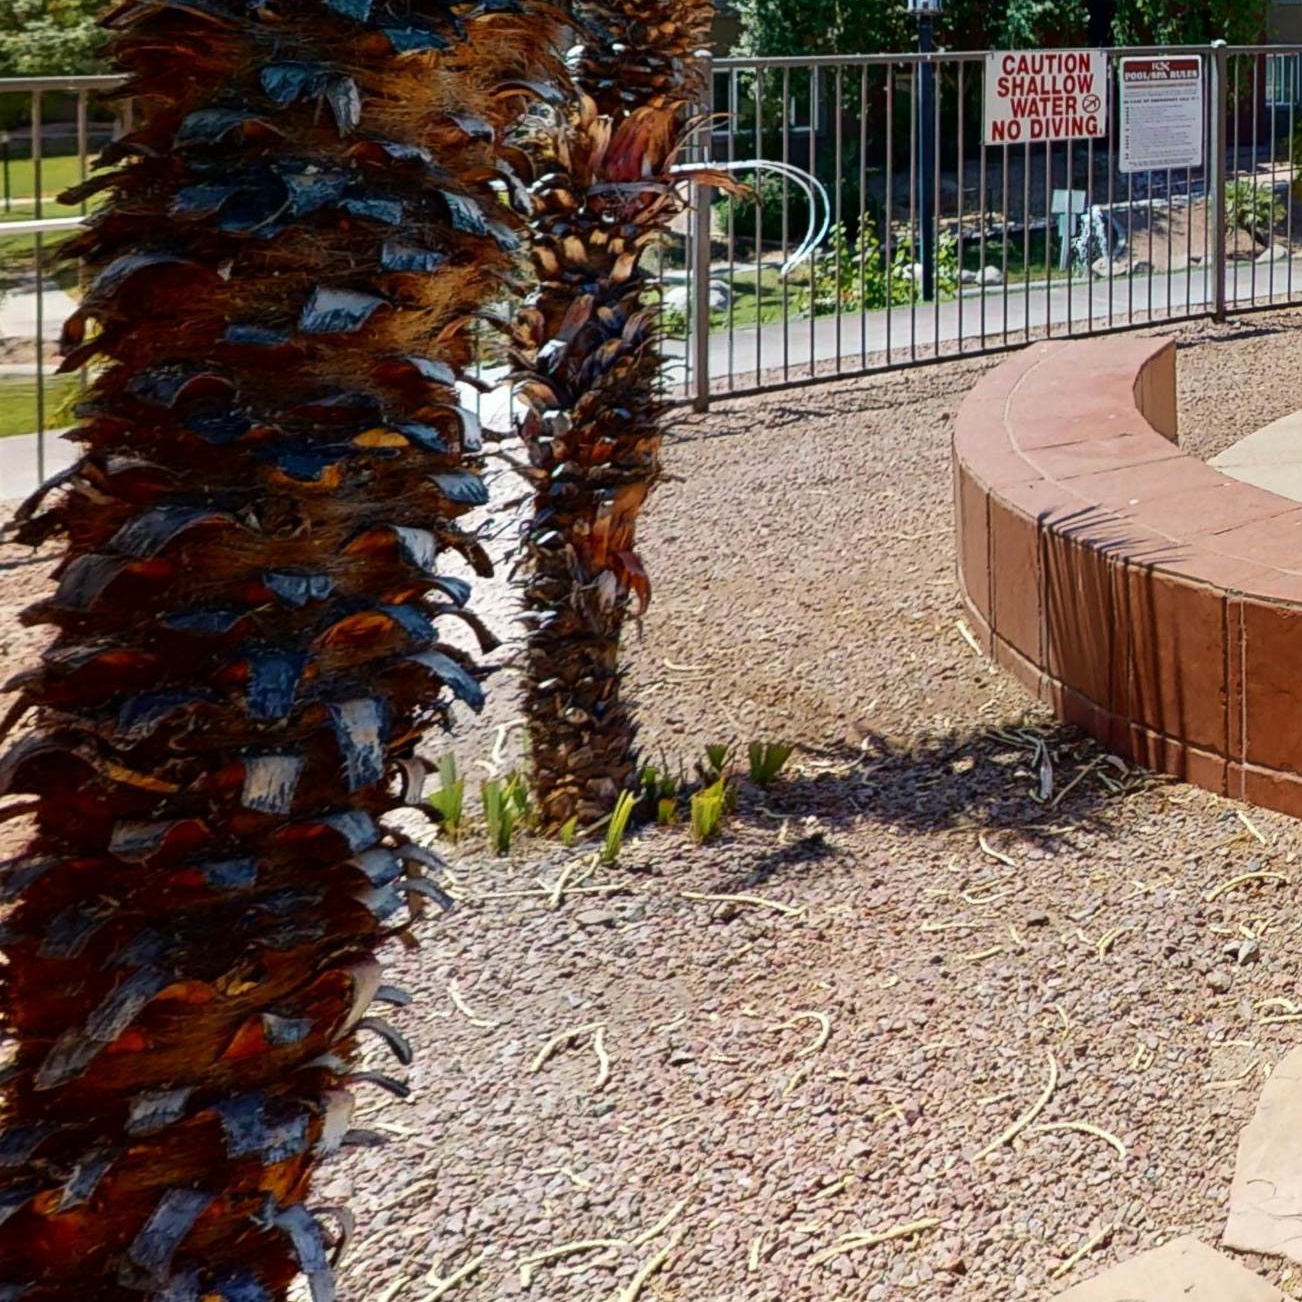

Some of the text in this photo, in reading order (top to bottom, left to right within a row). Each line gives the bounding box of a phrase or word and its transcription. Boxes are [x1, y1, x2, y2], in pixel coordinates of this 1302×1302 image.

[1002, 53, 1090, 75] CAUTION
[1125, 69, 1198, 80] POOL/SPA RULES
[997, 74, 1094, 97] SHALLOW
[1010, 95, 1077, 118] WATER
[992, 119, 1021, 141] NO
[1030, 115, 1098, 138] DIVING
